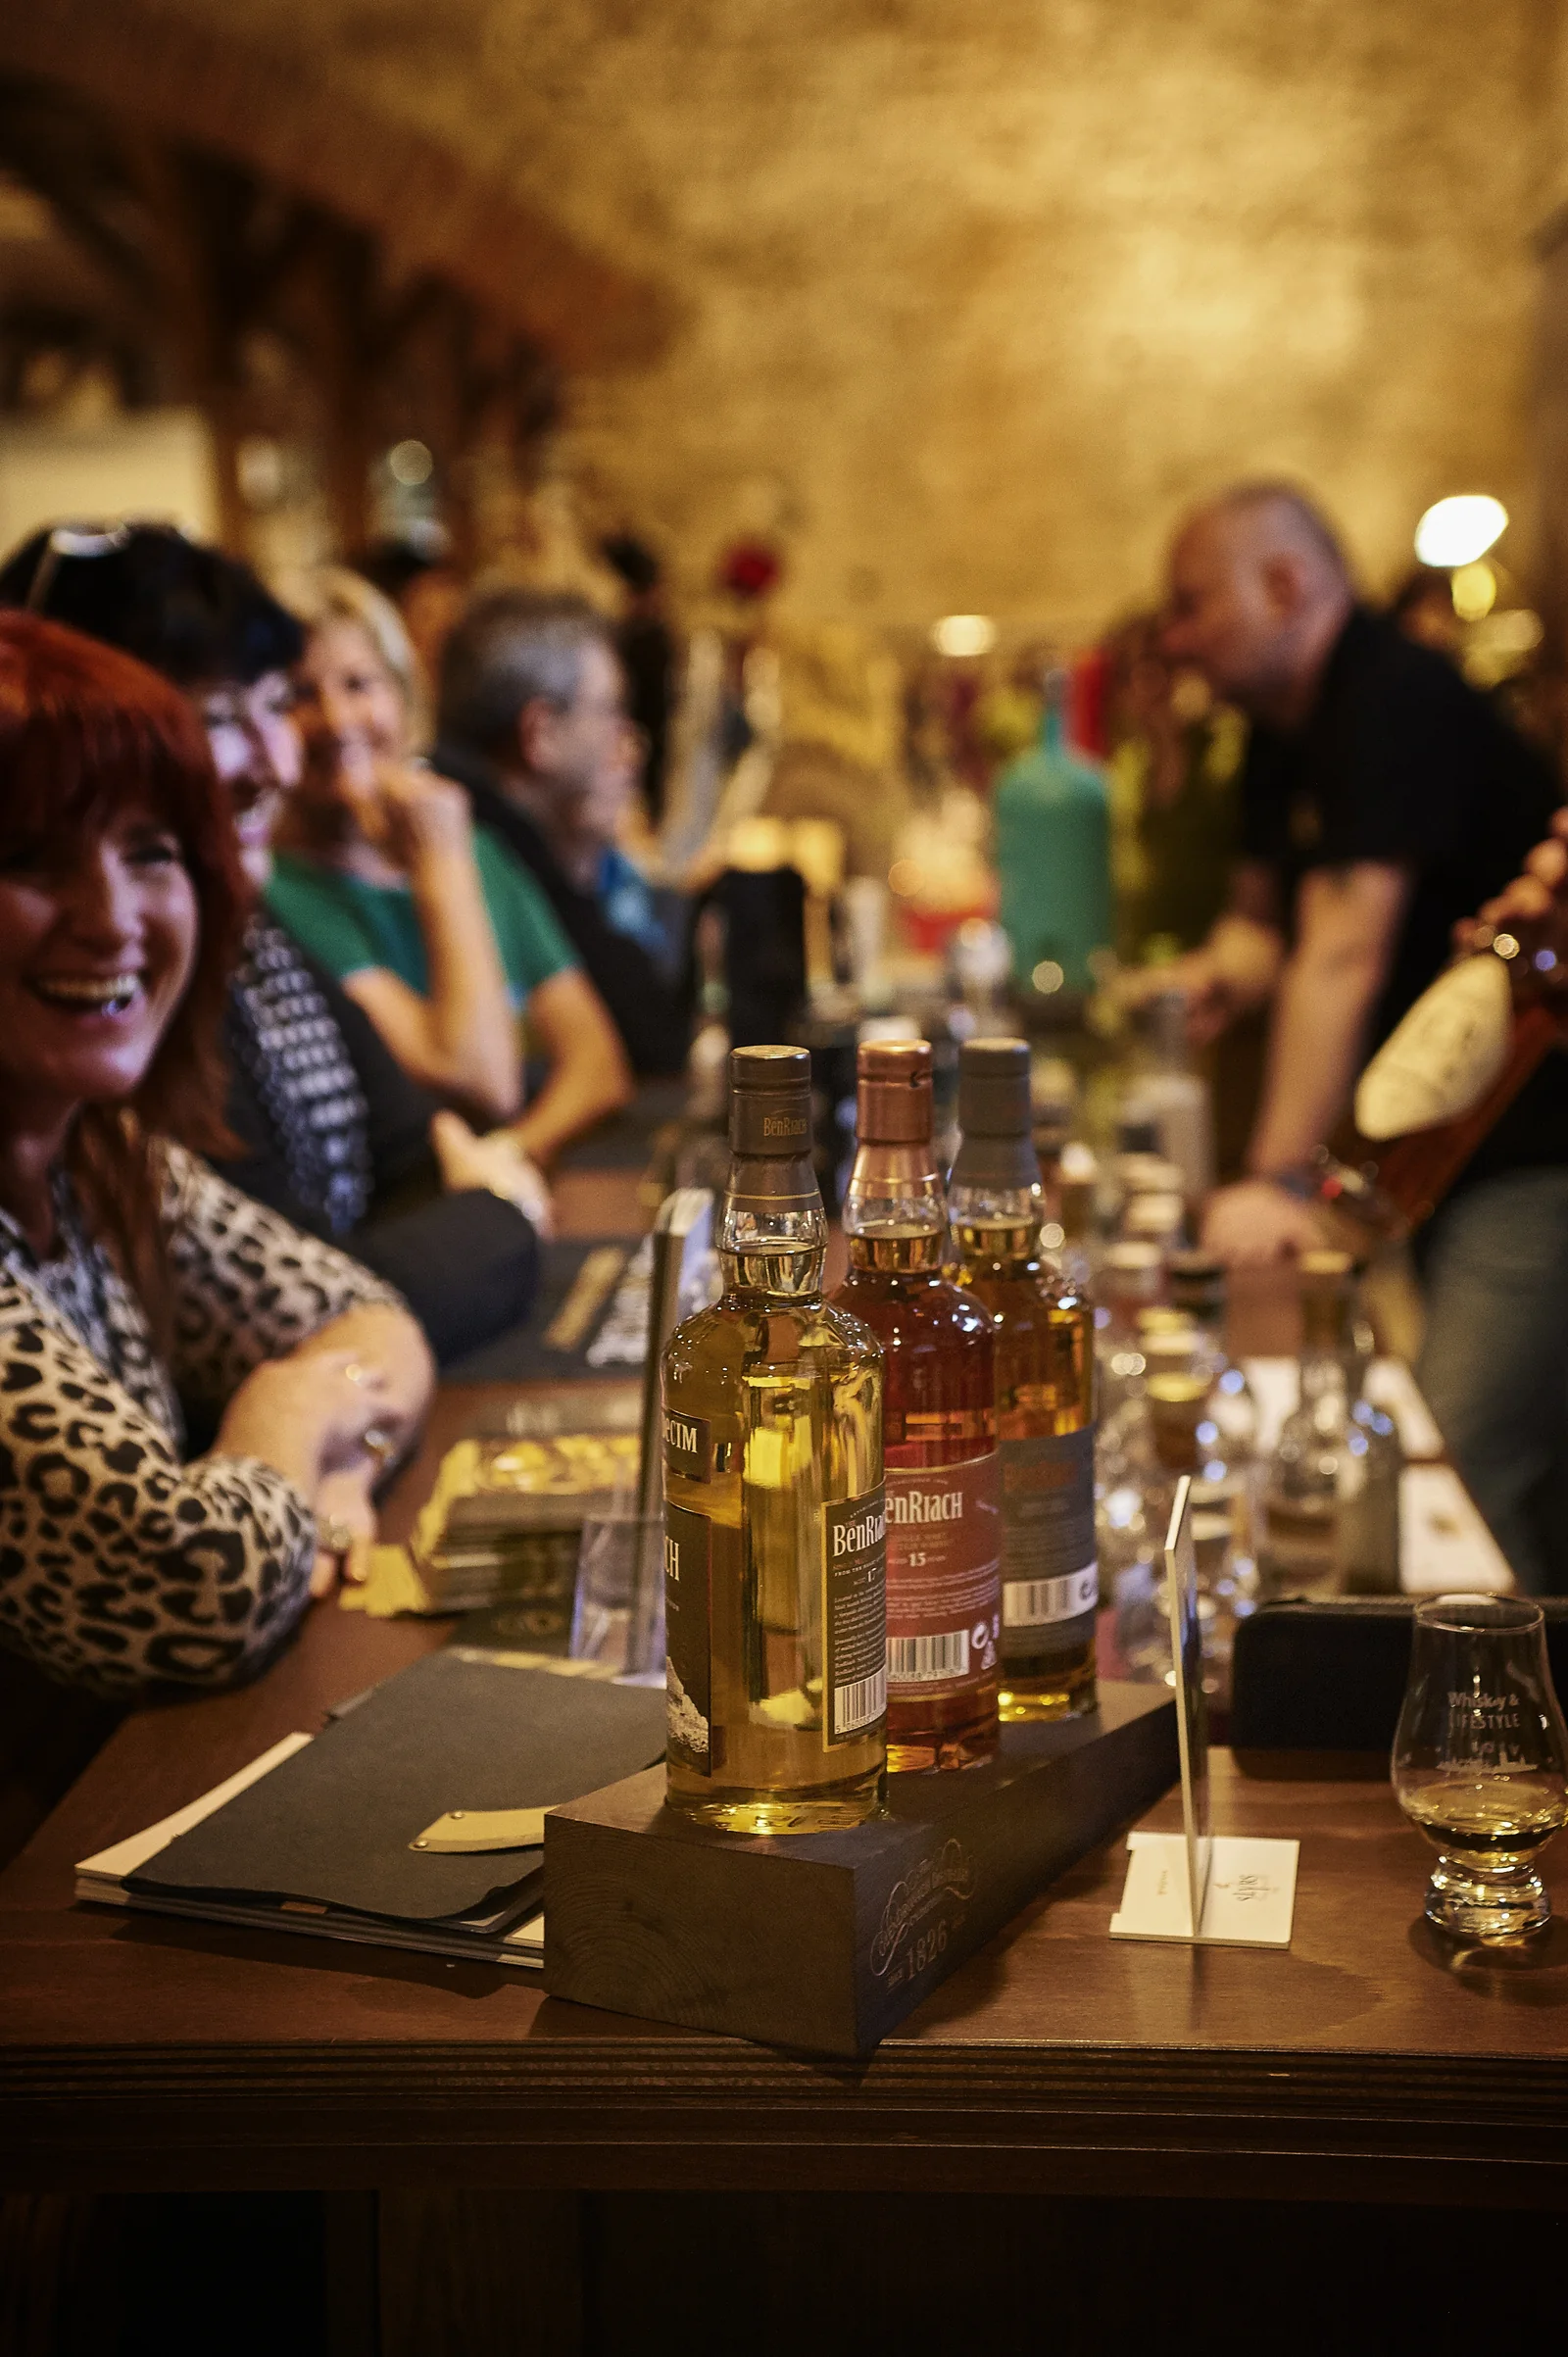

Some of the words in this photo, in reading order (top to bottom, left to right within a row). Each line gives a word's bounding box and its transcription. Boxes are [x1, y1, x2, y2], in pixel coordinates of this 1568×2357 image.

[885, 1491, 963, 1524] enRiacH
[908, 1552, 926, 1567] 15
[1509, 1694, 1520, 1706] &
